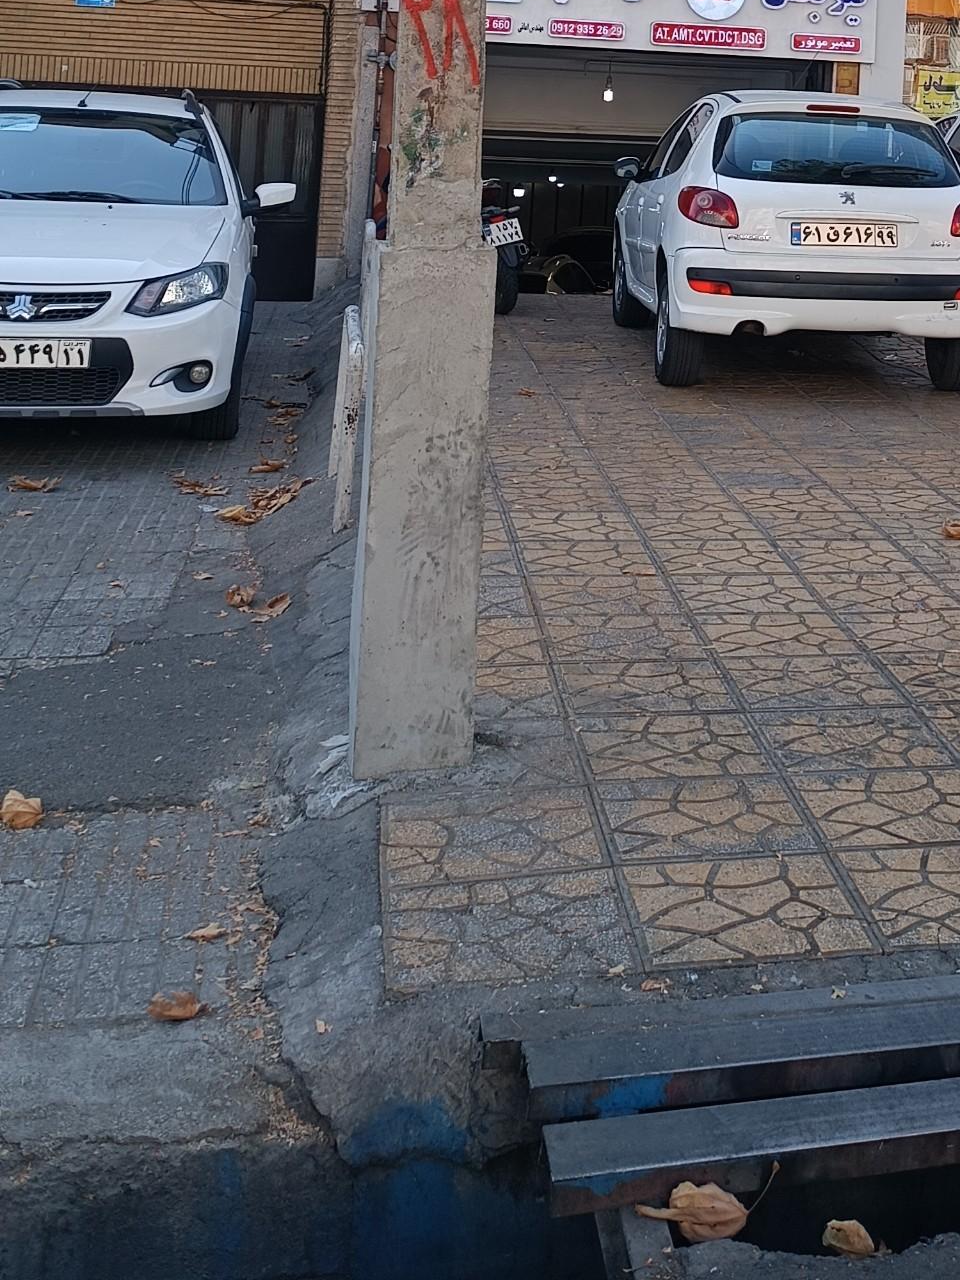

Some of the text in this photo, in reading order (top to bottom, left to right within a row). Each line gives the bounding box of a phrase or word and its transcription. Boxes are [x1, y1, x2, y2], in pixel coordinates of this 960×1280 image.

[493, 19, 510, 30] 660
[551, 22, 622, 36] 0912 935 26 29
[828, 38, 856, 50] تعمیر
[802, 225, 896, 245] ۶۱ ق ۶۱۶ ۹۹
